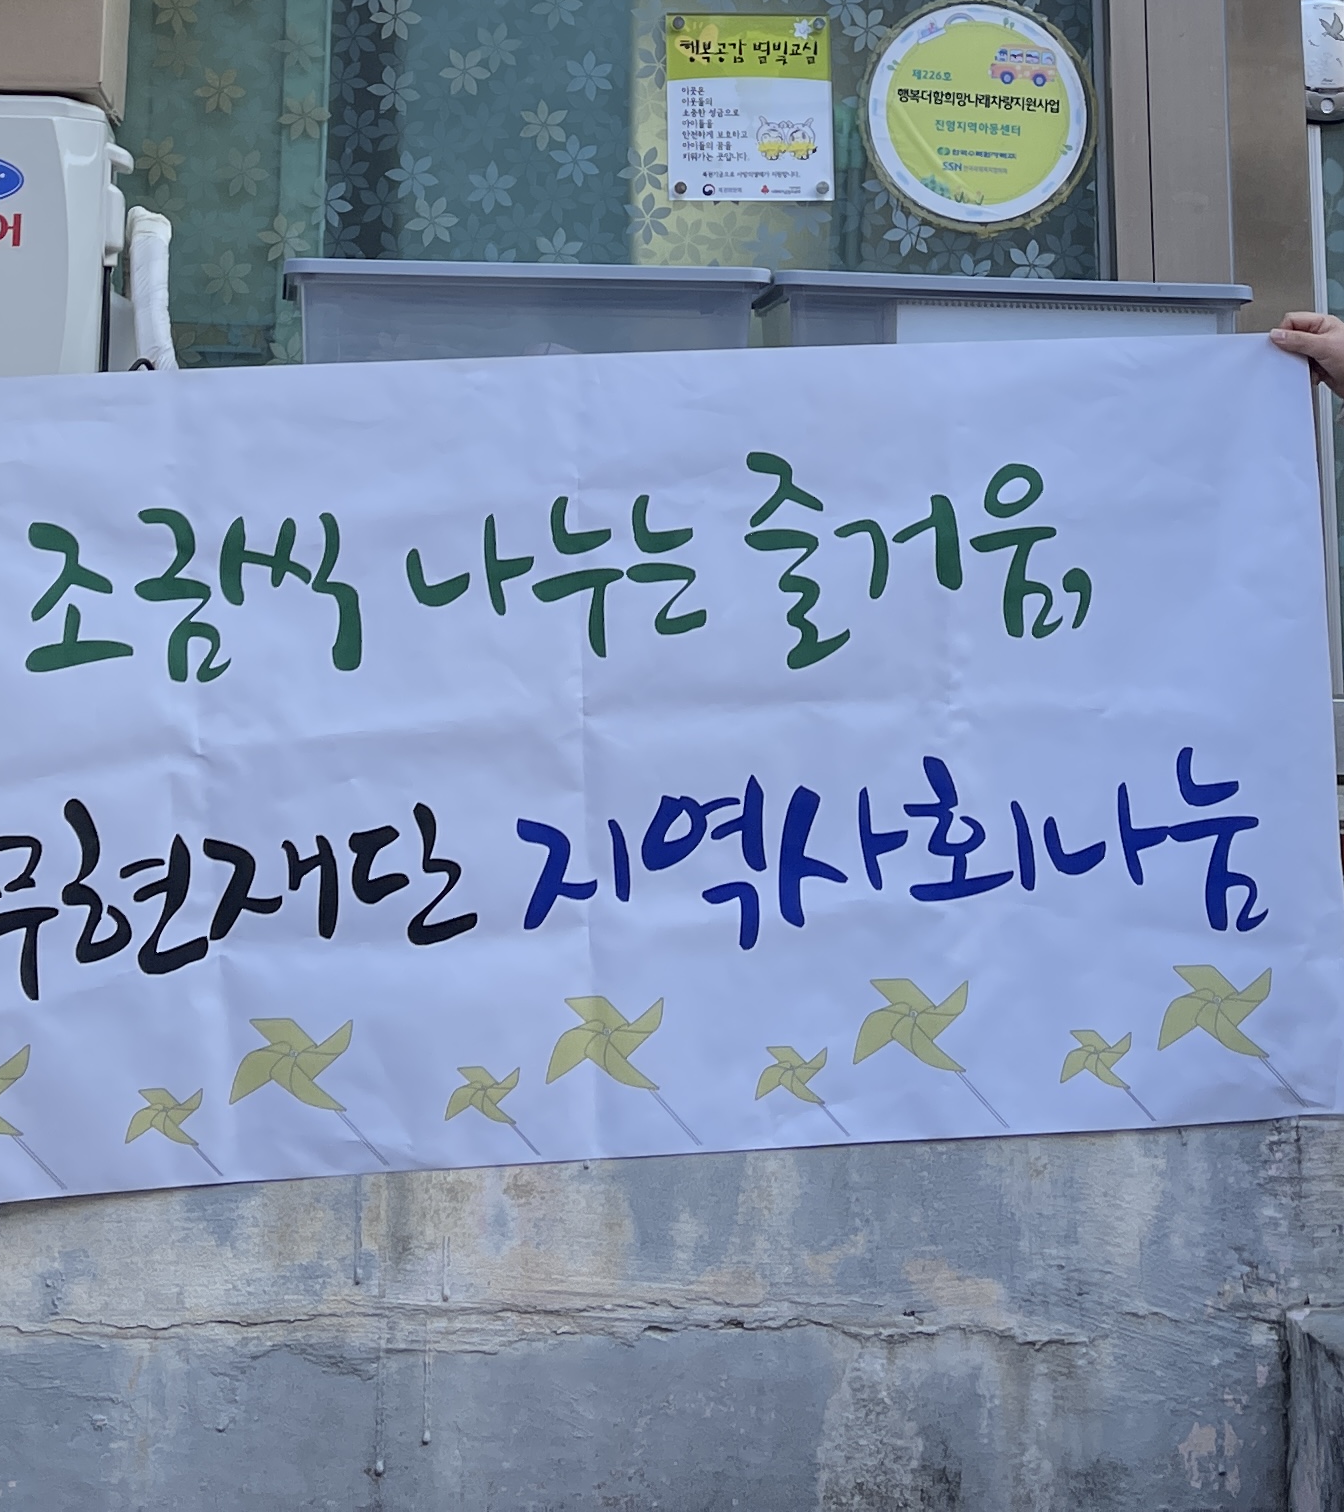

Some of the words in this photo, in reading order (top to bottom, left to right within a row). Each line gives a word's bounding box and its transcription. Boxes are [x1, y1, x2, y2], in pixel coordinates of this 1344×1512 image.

[912, 69, 953, 82] 제226호
[934, 119, 1022, 136] 진영지역아동센터
[25, 508, 363, 683] 조금씩
[405, 494, 707, 658] 나누는
[744, 451, 1093, 670] 즐거움,
[516, 746, 1269, 951] 지역사회나눔
